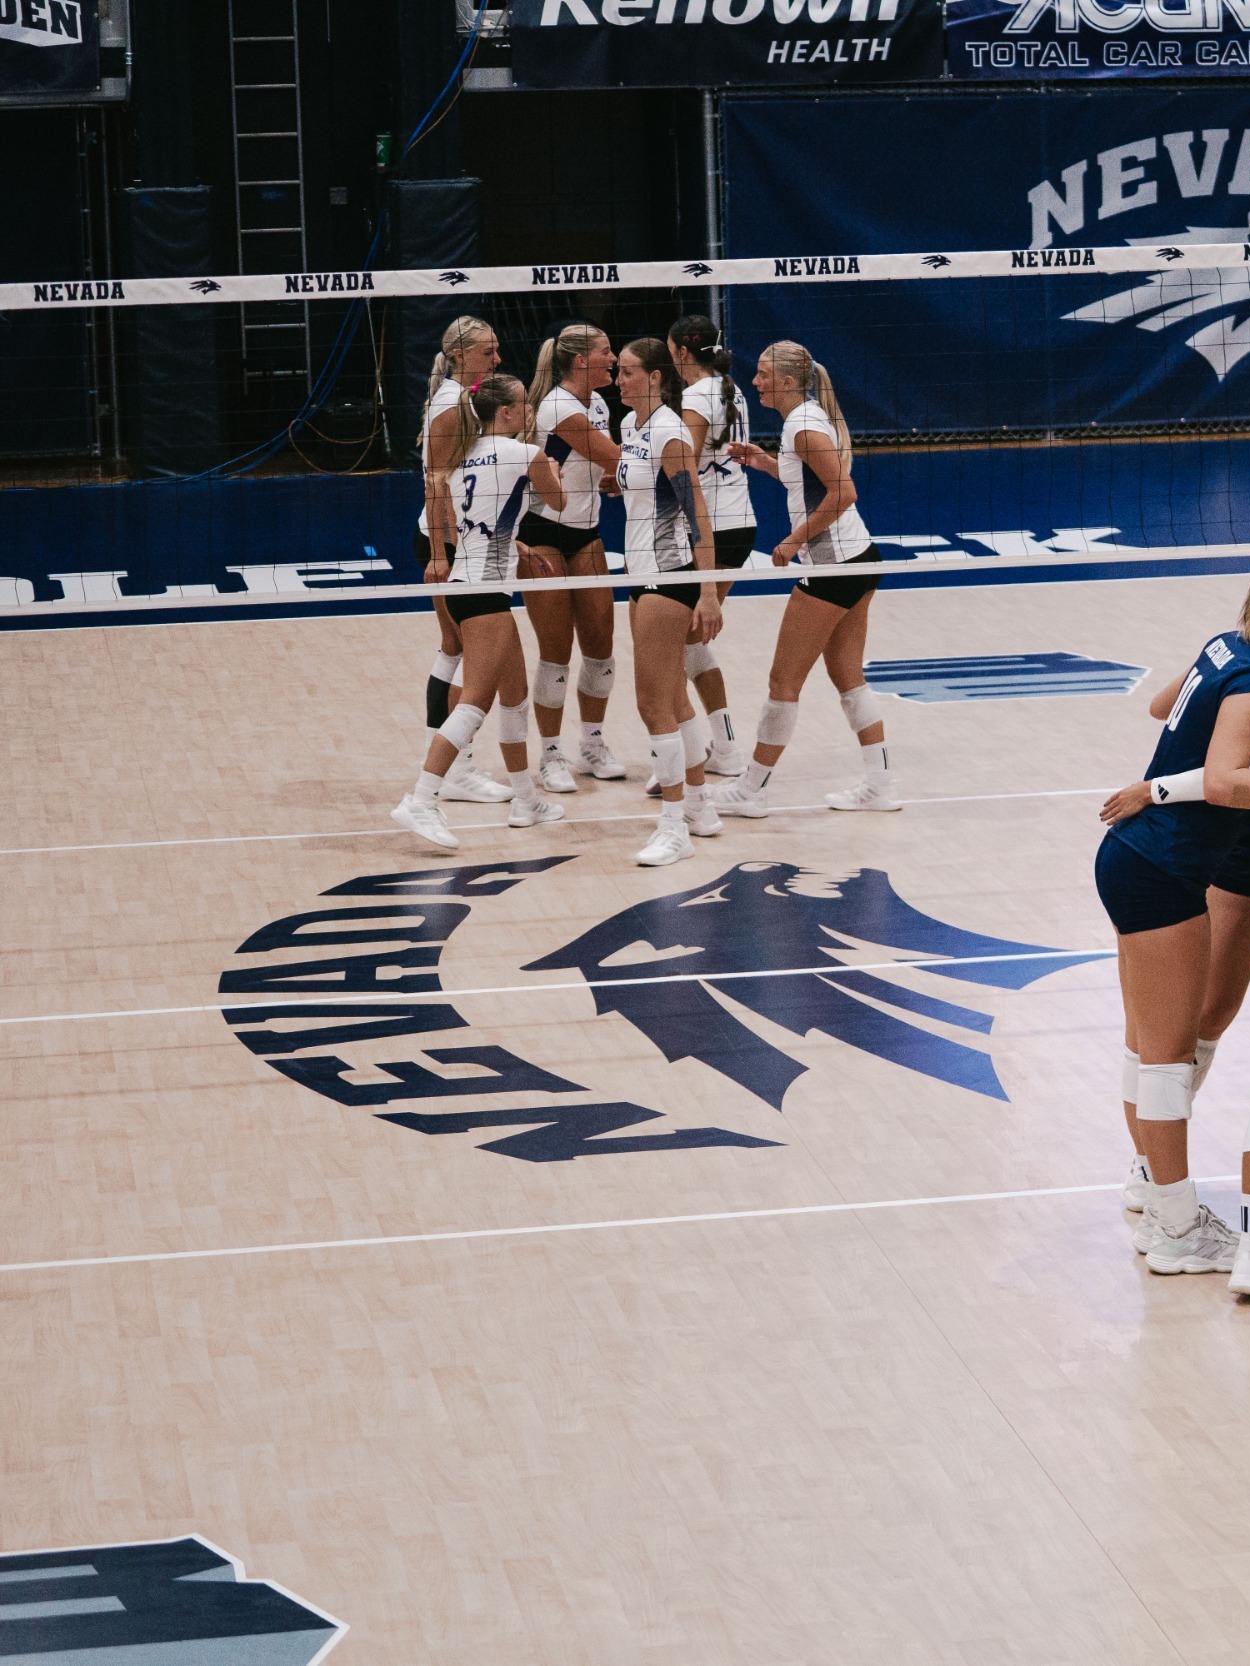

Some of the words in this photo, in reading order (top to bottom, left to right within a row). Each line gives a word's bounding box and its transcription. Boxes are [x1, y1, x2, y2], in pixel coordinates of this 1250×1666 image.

[767, 37, 891, 64] HEALTH
[965, 41, 1089, 67] TOTAL
[1103, 41, 1182, 66] CAR
[775, 257, 860, 276] NEVADA
[1012, 249, 1095, 267] NEVADA
[285, 273, 374, 293] NEVADA
[532, 265, 619, 285] NEVADA
[34, 282, 125, 302] NEVADA
[218, 855, 788, 1162] NEVADA
